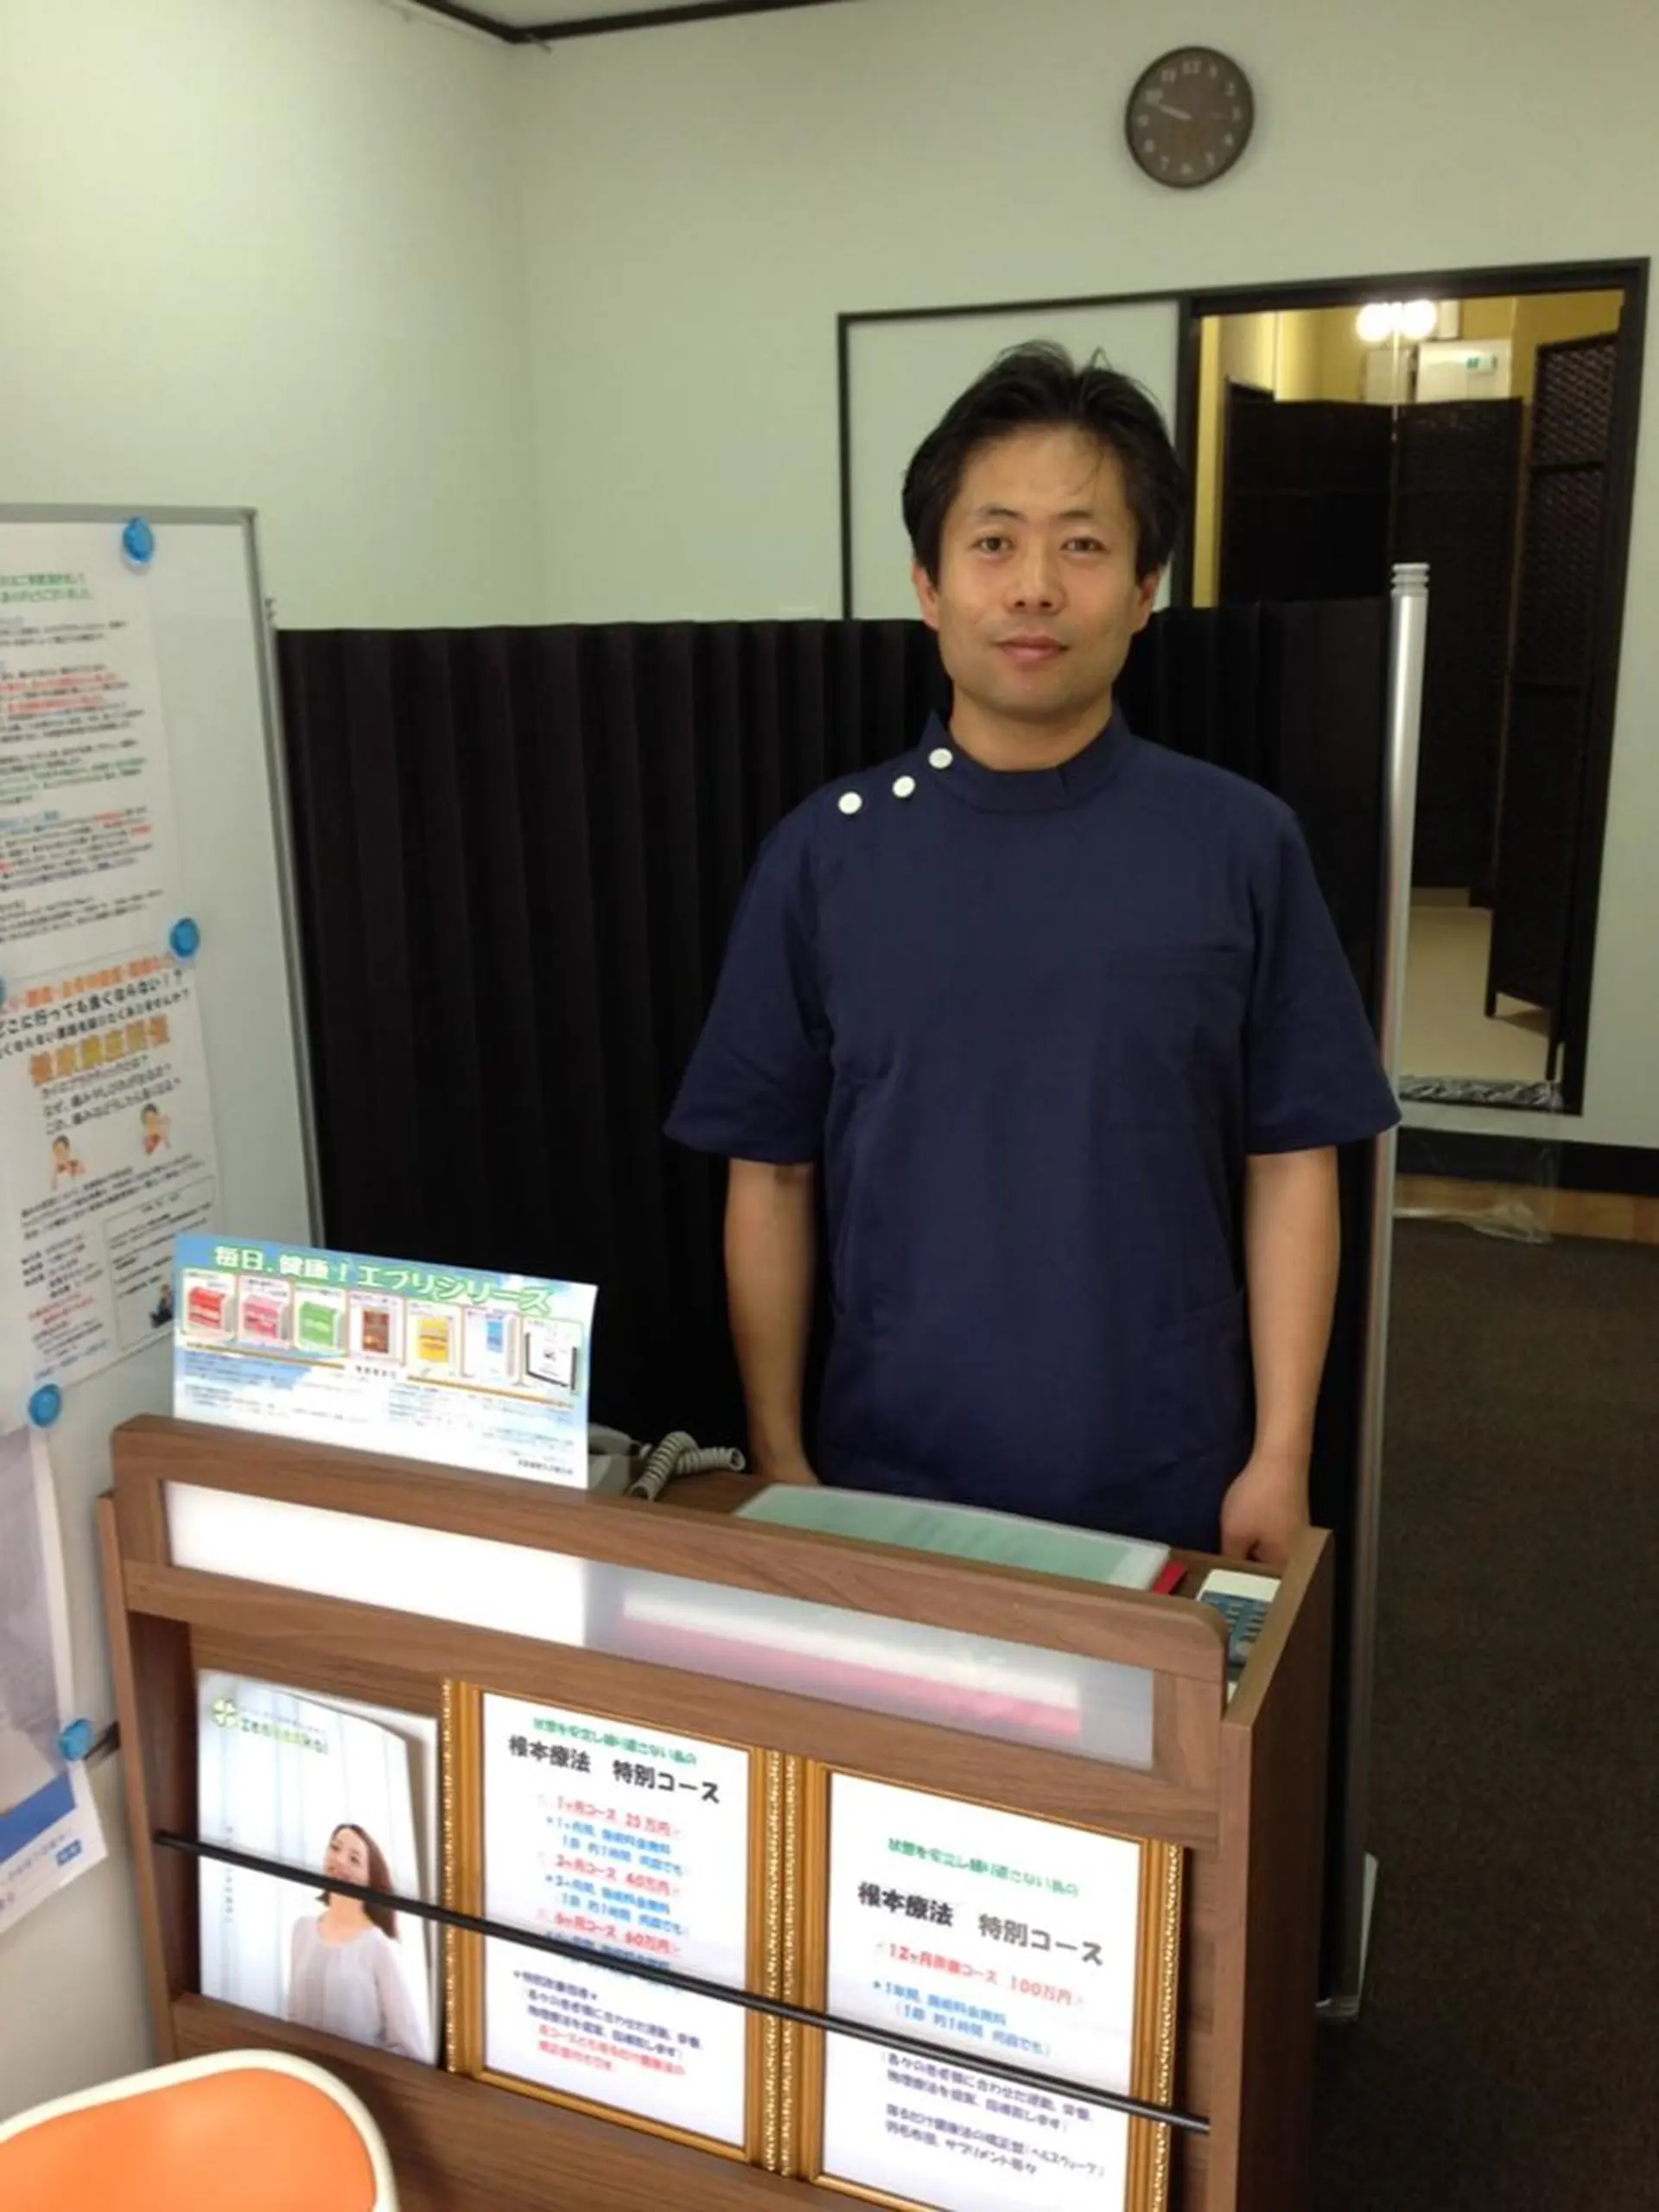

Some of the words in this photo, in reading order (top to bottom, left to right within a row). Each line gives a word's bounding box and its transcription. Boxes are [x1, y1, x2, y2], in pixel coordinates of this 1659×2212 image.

[508, 1734, 592, 1775] 根本療法
[613, 1759, 721, 1805] 特別コース
[857, 1882, 955, 1928] 根本療法
[978, 1913, 1105, 1967] 特別コース
